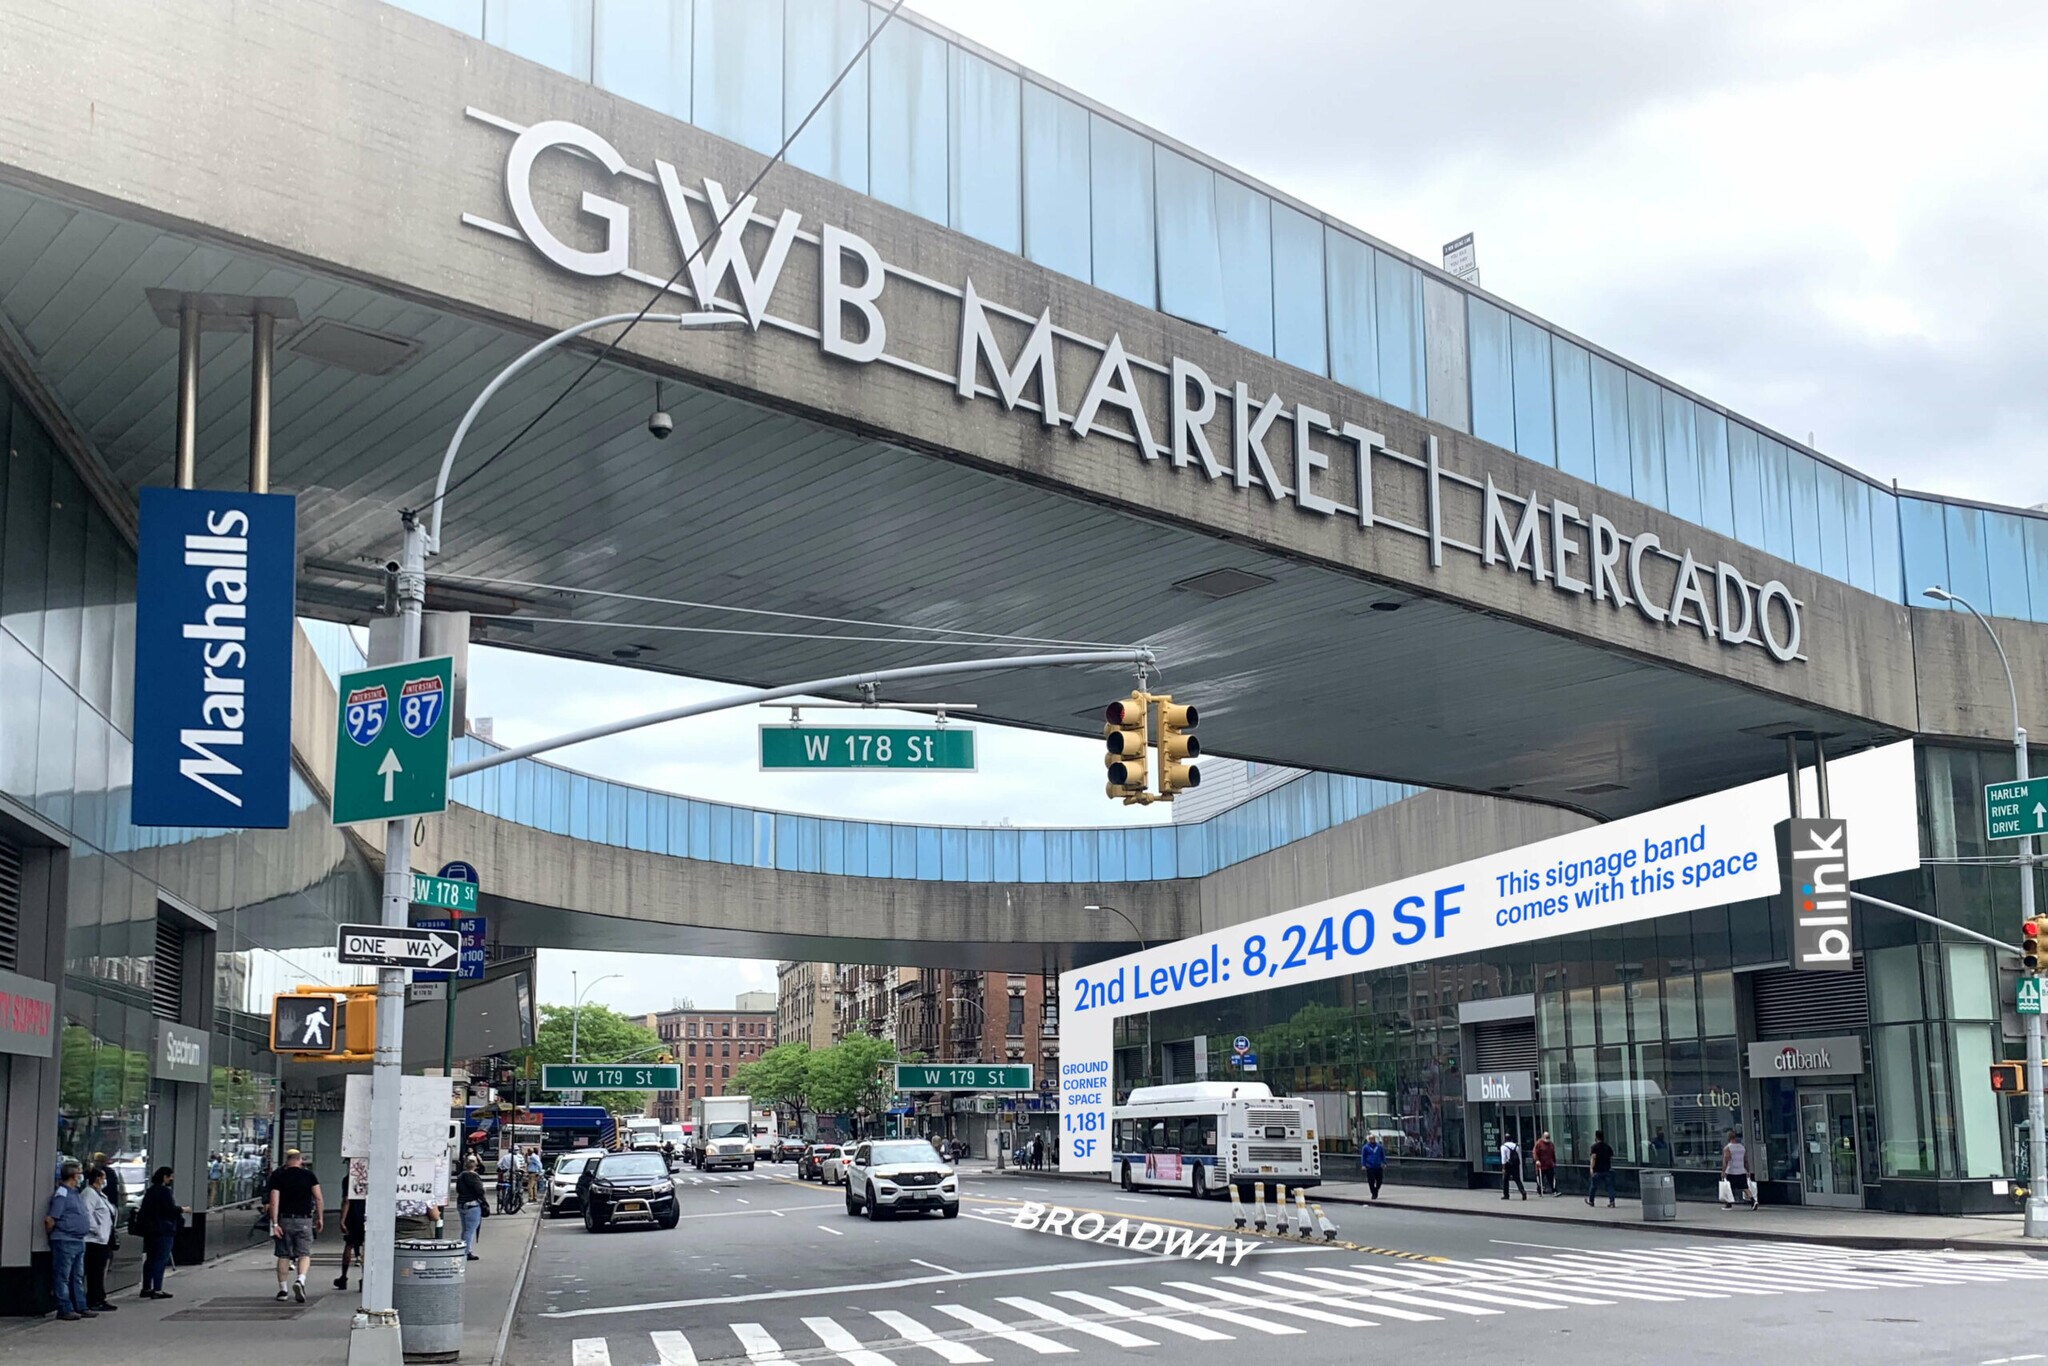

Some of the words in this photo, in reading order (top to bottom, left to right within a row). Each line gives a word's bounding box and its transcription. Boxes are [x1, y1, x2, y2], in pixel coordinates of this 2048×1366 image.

[504, 120, 886, 363] GWB
[956, 275, 1385, 528] MARKET
[1482, 473, 1804, 663] MERCADO
[179, 509, 249, 807] Marshalls
[351, 689, 383, 702] INTERSTATE
[405, 680, 439, 693] INTERSTATE
[349, 702, 383, 737] 95
[404, 694, 438, 730] 87
[804, 735, 830, 761] W
[845, 735, 892, 762] 178
[907, 735, 934, 762] St
[1990, 785, 2029, 801] HARLEM
[1991, 803, 2020, 818] RIVER
[1992, 820, 2021, 834] DRIVE
[416, 878, 430, 901] W
[436, 881, 459, 906] 178
[464, 886, 474, 901] St
[1793, 825, 1850, 962] blink
[461, 920, 476, 932] M5
[350, 938, 387, 954] ONE
[407, 941, 443, 958] WAY
[461, 935, 475, 947] M5
[460, 950, 484, 962] M100
[13, 994, 51, 1037] SUPPLY
[166, 1031, 200, 1070] Spectrum
[1774, 1047, 1831, 1070] citibank
[572, 1070, 588, 1085] W
[597, 1070, 623, 1085] 179
[635, 1070, 653, 1085] St
[924, 1070, 940, 1085] W
[949, 1070, 975, 1085] 179
[988, 1070, 1005, 1085] St
[1481, 1074, 1511, 1099] blink
